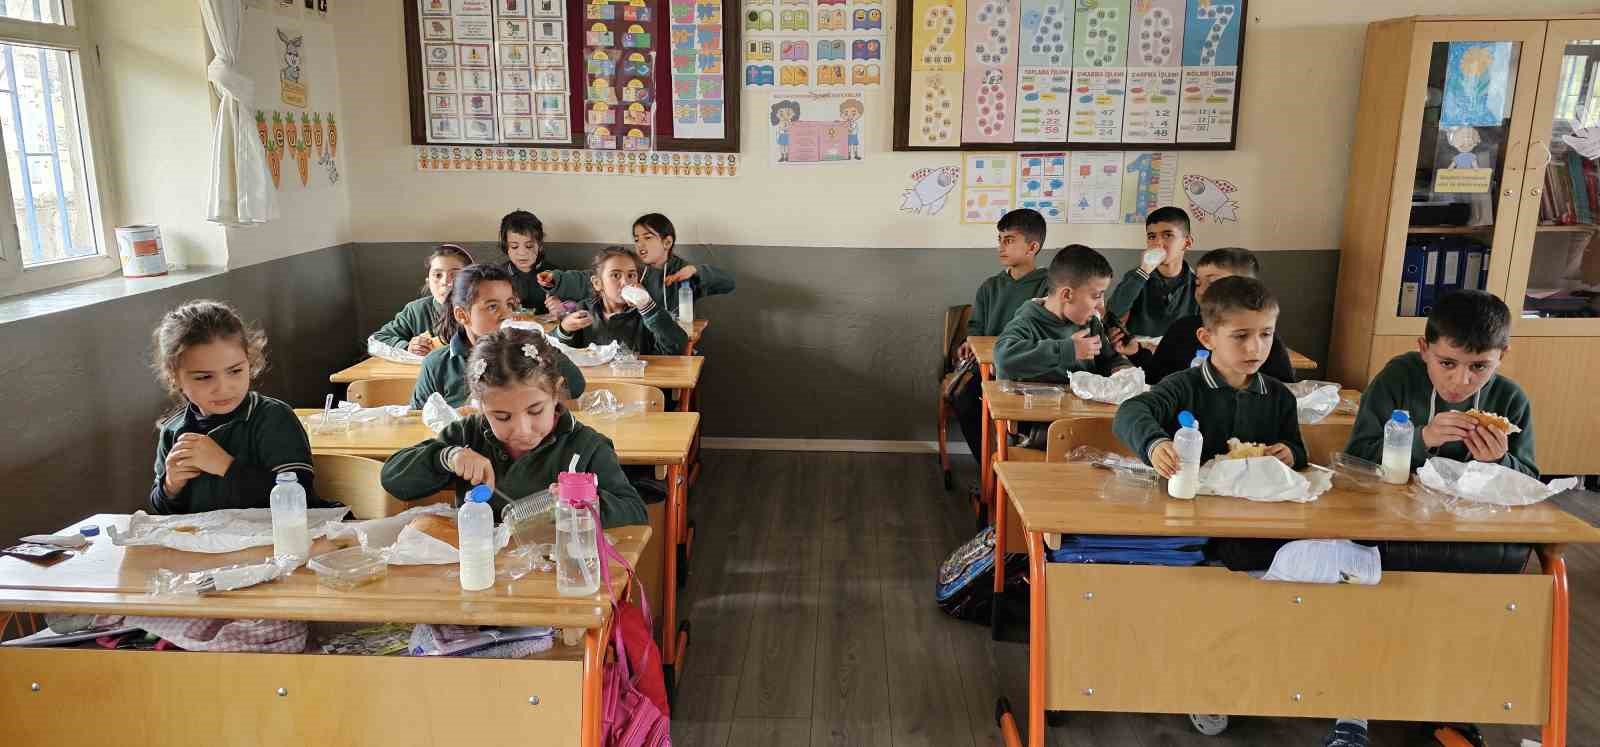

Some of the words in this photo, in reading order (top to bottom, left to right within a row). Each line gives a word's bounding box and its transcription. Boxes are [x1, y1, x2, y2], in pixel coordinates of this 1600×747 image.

[922, 4, 957, 65] 2
[1083, 7, 1121, 68] 5
[1139, 7, 1175, 66] 6
[1196, 5, 1236, 67] 7
